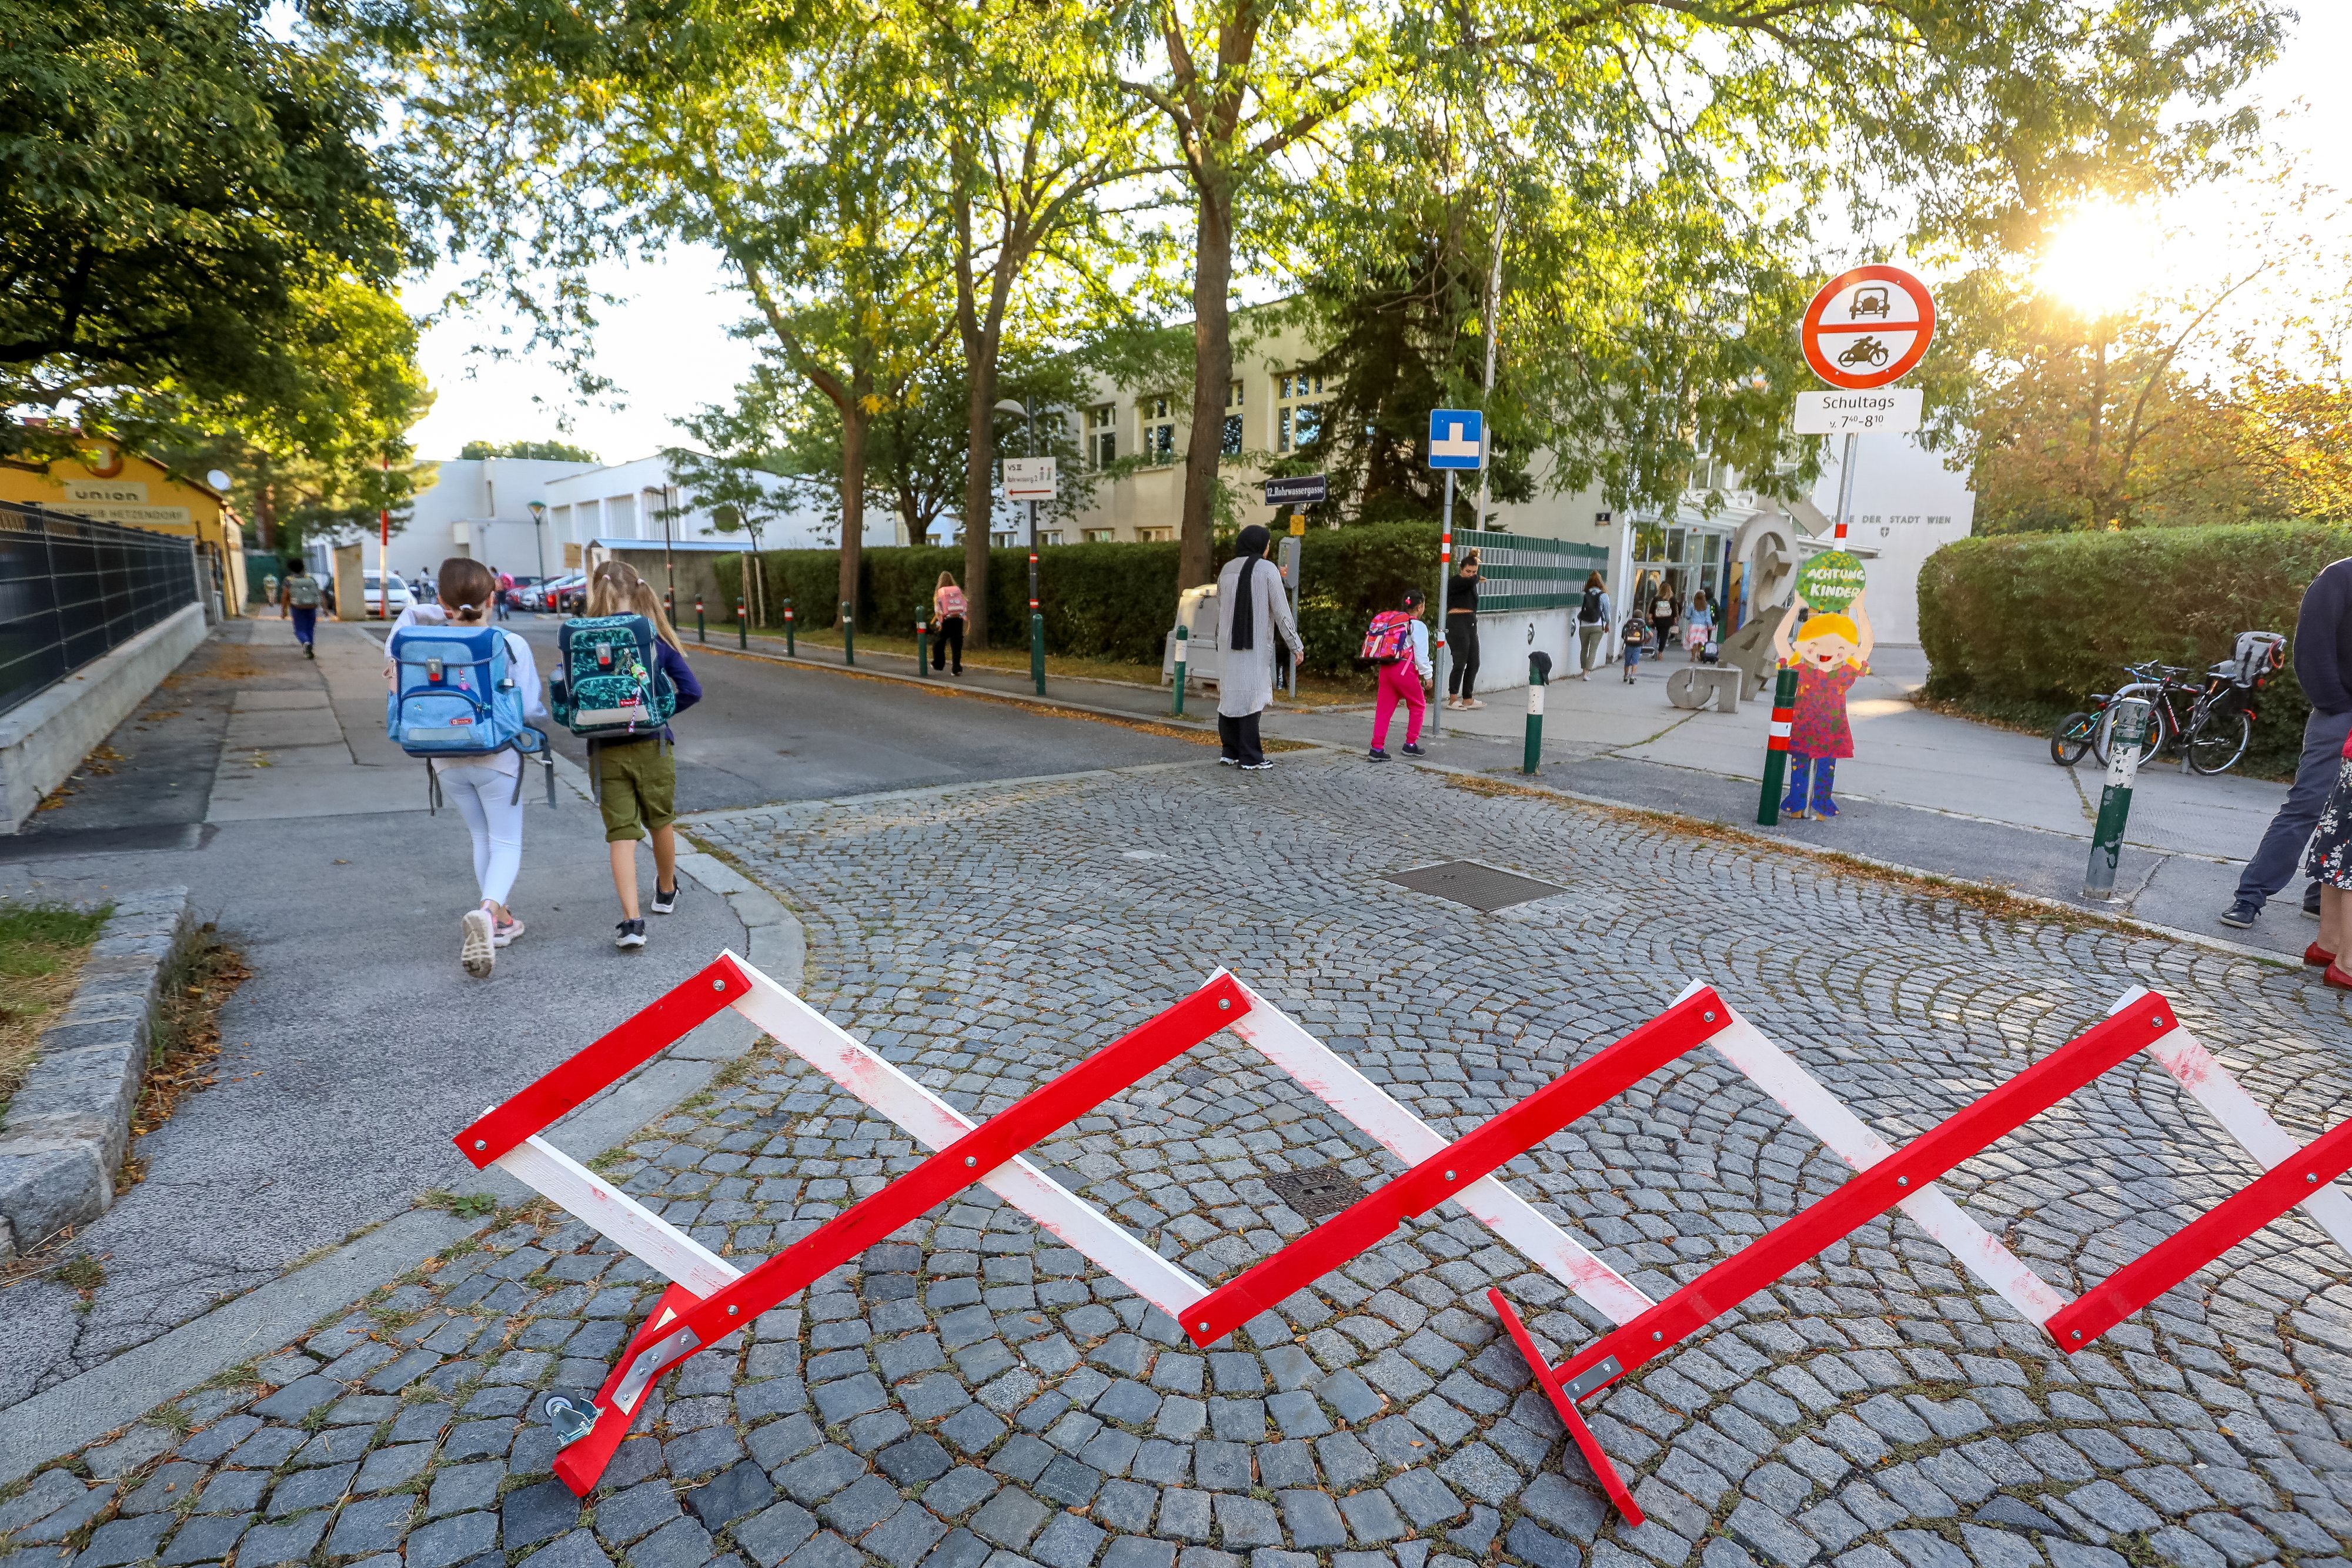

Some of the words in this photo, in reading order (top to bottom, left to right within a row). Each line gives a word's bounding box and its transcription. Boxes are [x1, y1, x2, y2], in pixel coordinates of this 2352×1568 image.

[1822, 396, 1895, 410] Schultags
[75, 490, 139, 502] union
[1274, 486, 1324, 497] Rohrwassergasse
[1862, 515, 1881, 523] DER
[1890, 515, 1920, 524] STADT
[1927, 515, 1951, 524] WIEN
[1806, 568, 1866, 581] ACHTUNG
[1810, 583, 1861, 599] KINDER
